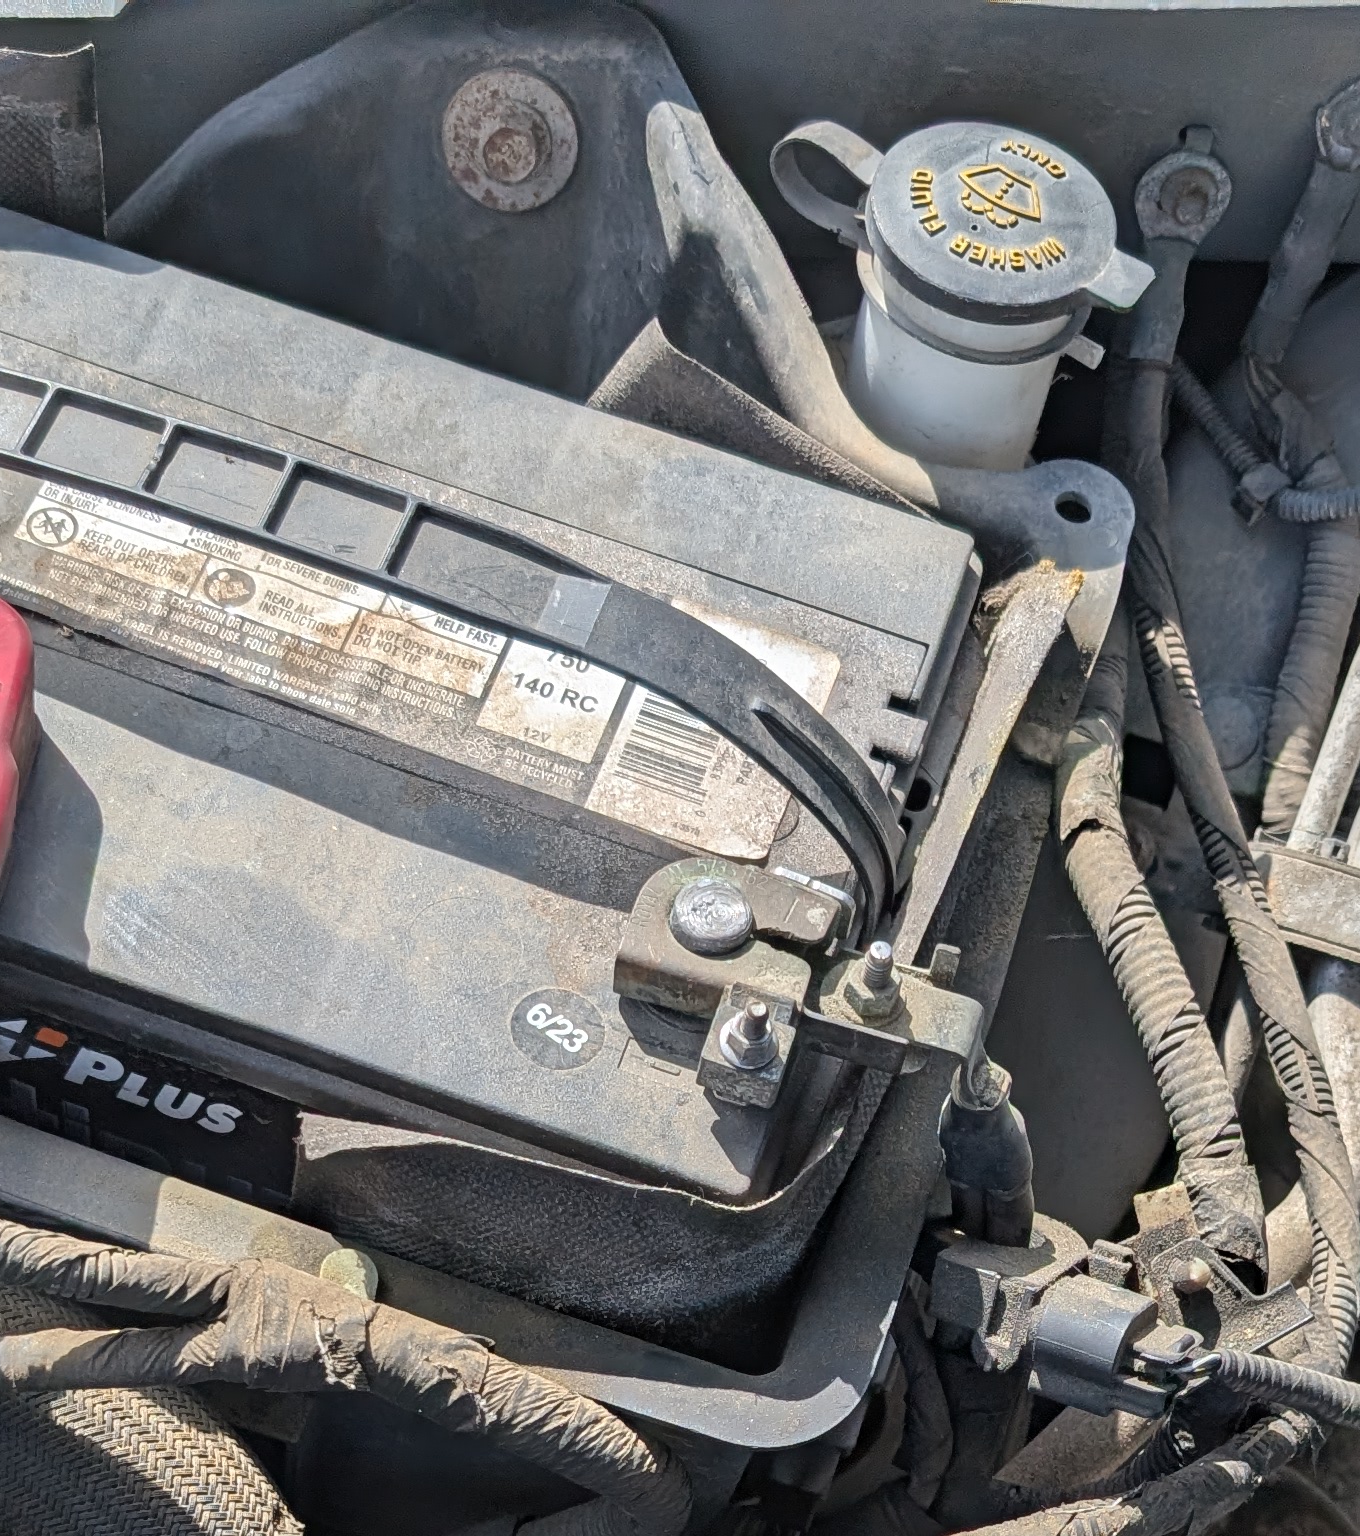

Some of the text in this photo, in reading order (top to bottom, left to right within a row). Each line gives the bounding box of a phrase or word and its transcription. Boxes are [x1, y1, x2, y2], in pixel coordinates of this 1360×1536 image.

[910, 138, 1067, 272] WASHER FLUID ONLY
[43, 486, 59, 499] OR
[60, 492, 100, 513] INJURY.
[106, 499, 162, 523] BLINDNESS
[77, 539, 114, 559] REACH
[116, 552, 132, 565] OF
[83, 528, 112, 545] KEEP
[112, 538, 135, 553] OUT
[138, 547, 153, 559] OF
[193, 537, 242, 561] SMOKING
[266, 556, 362, 596] OR SEVERE BURNS.
[258, 600, 344, 639] INSTRUCTIONS.
[262, 590, 317, 617] READ ALL
[47, 568, 69, 583] NOT
[69, 576, 147, 611] RECOMMENDED
[147, 602, 169, 618] FOR
[168, 611, 218, 636] INVERTED
[218, 628, 243, 644] USE.
[243, 636, 286, 659] FOLLOW
[286, 651, 328, 674] PROPER
[328, 664, 382, 692] CHARGING
[101, 572, 126, 589] RISK
[168, 596, 226, 623] EXPLOSION
[225, 615, 243, 629] OR
[242, 621, 281, 643] BURNS.
[281, 634, 298, 649] DO
[298, 640, 321, 657] NOT
[320, 647, 390, 680] DISASSEMBLE
[389, 672, 406, 686] OR
[352, 634, 371, 648] DO
[373, 639, 399, 656] NOT
[433, 616, 500, 647] HELP FAST.
[124, 616, 156, 636] LABEL
[156, 628, 171, 642] IS
[170, 634, 226, 661] REMOVED.
[227, 654, 271, 676] LIMITED
[271, 669, 331, 697] WARRANTY
[332, 689, 358, 705] valid
[357, 623, 487, 675] DO NOT OPEN BATTERY.
[266, 679, 280, 691] to
[280, 684, 308, 700] show
[308, 693, 332, 708] date
[510, 671, 600, 714] 140 RC
[521, 726, 551, 744] 12V
[504, 747, 584, 781] BATTERY MUST
[522, 763, 573, 789] RECYCLED
[631, 886, 664, 927] ROYAL
[526, 1002, 589, 1053] 6/23
[64, 1047, 243, 1134] PLUS
